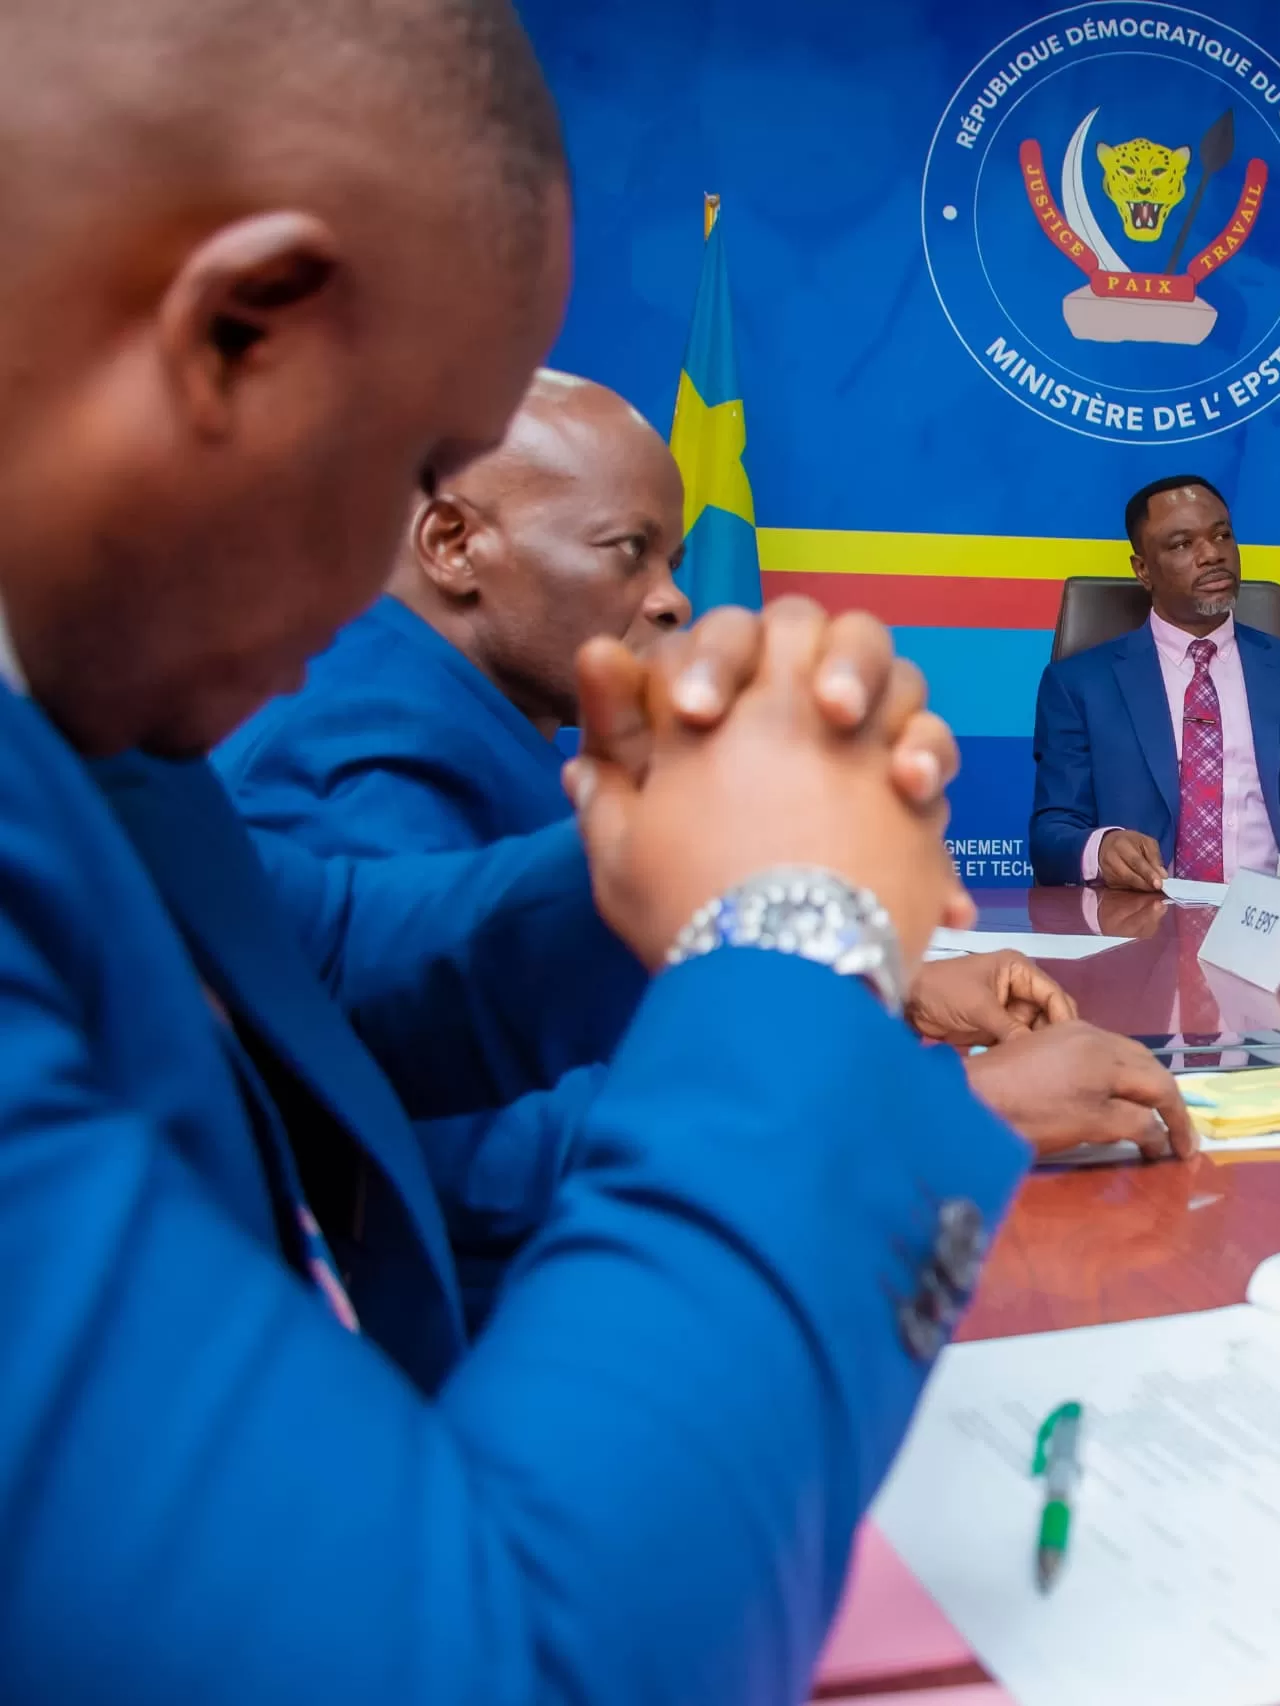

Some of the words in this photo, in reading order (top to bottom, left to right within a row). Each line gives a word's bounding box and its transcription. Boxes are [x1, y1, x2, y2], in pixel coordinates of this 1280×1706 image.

[956, 34, 1064, 150] RÉPUBLIQUE
[1067, 18, 1252, 77] DÉMOCRATIQUE
[1026, 164, 1086, 258] JUSTICE
[1201, 183, 1262, 271] TRAVAIL
[1108, 276, 1172, 294] PAIX
[985, 337, 1144, 431] MINISTÈRE
[1153, 401, 1197, 431] DE
[966, 861, 987, 877] ET
